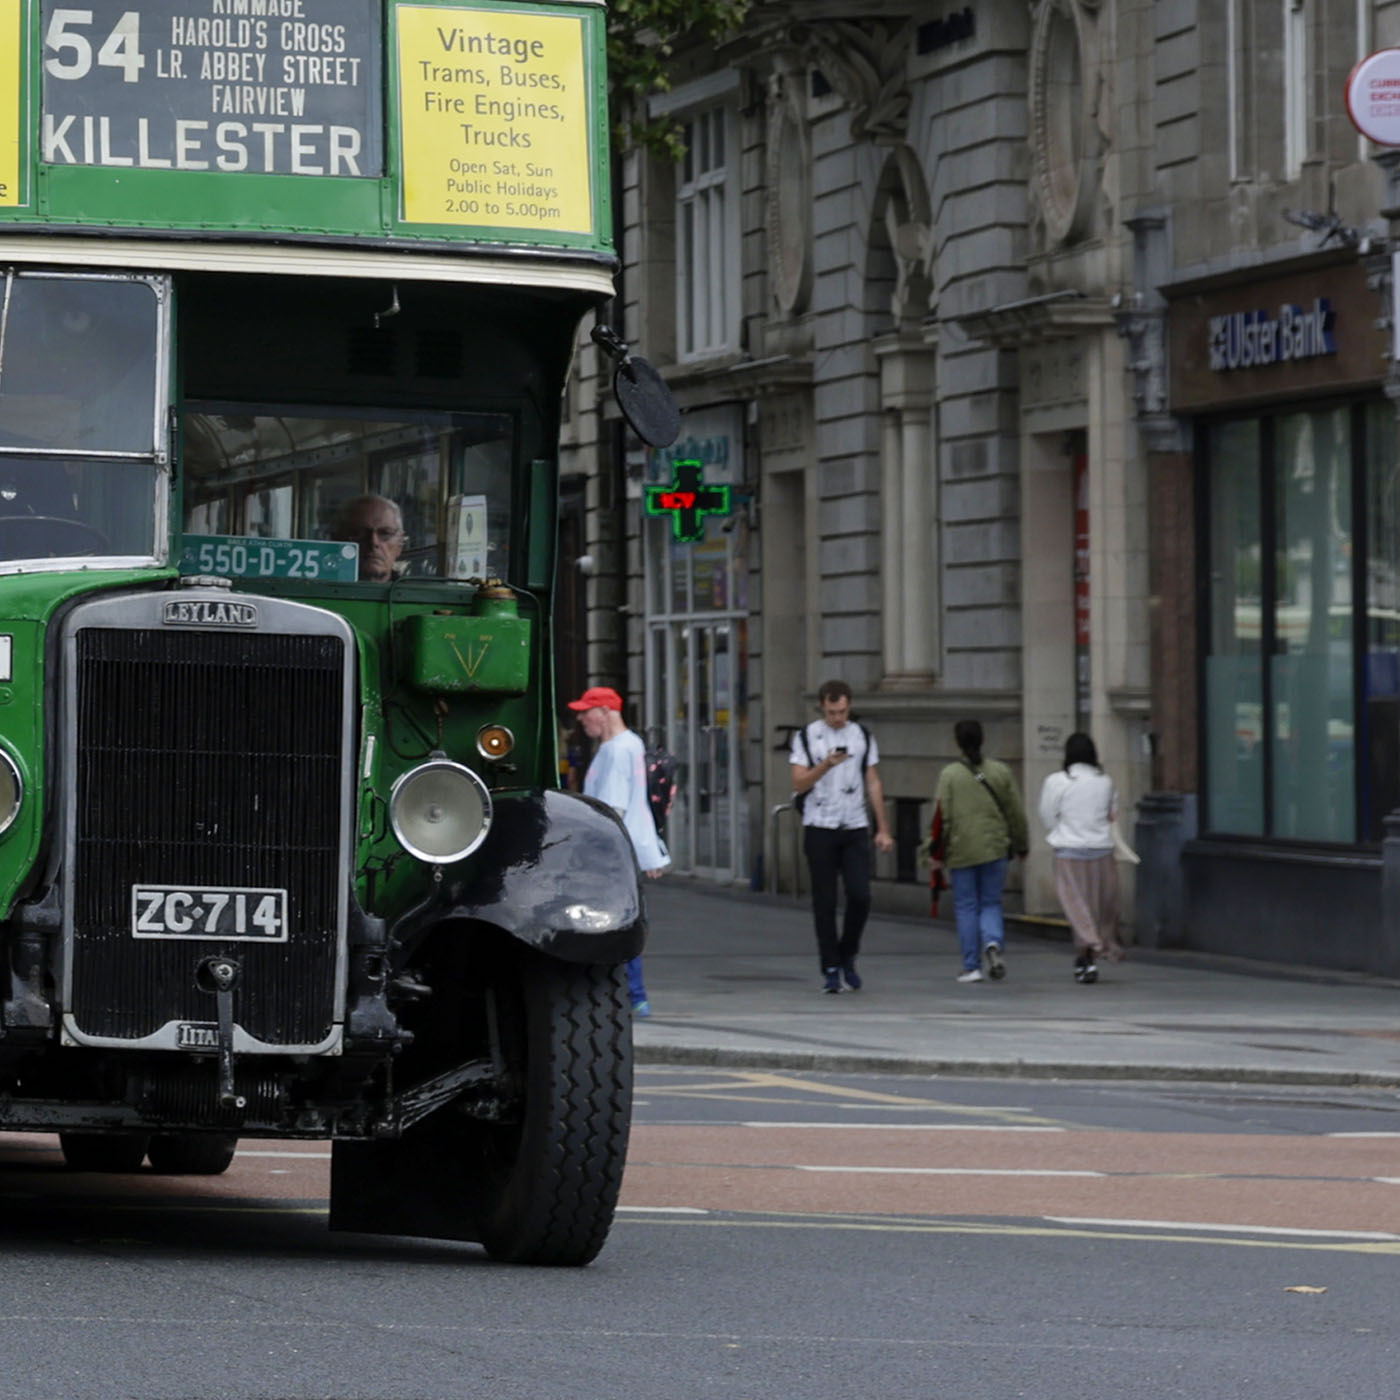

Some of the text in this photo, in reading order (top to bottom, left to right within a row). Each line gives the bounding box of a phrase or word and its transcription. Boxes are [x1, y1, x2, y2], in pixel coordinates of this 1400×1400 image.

[45, 8, 145, 83] 54
[171, 16, 345, 53] HAROLD'S CROSS
[437, 27, 545, 63] Vintage
[156, 49, 361, 86] LR. ABBEY STREET
[419, 61, 567, 92] Trams, Buses,
[212, 84, 305, 117] FAIRVIEW
[424, 92, 565, 122] Fire Engines,
[45, 114, 361, 177] KILLESTER
[460, 124, 532, 148] Trucks
[449, 158, 487, 175] Open
[526, 163, 553, 177] Sun
[446, 178, 558, 200] Public Holidays
[446, 199, 561, 220] 2.00 to 5.00pm
[1225, 297, 1328, 369] Ulster Bank
[200, 544, 320, 578] 550-D-25
[166, 602, 256, 624] LEYLAND
[180, 1024, 219, 1046] TITA
